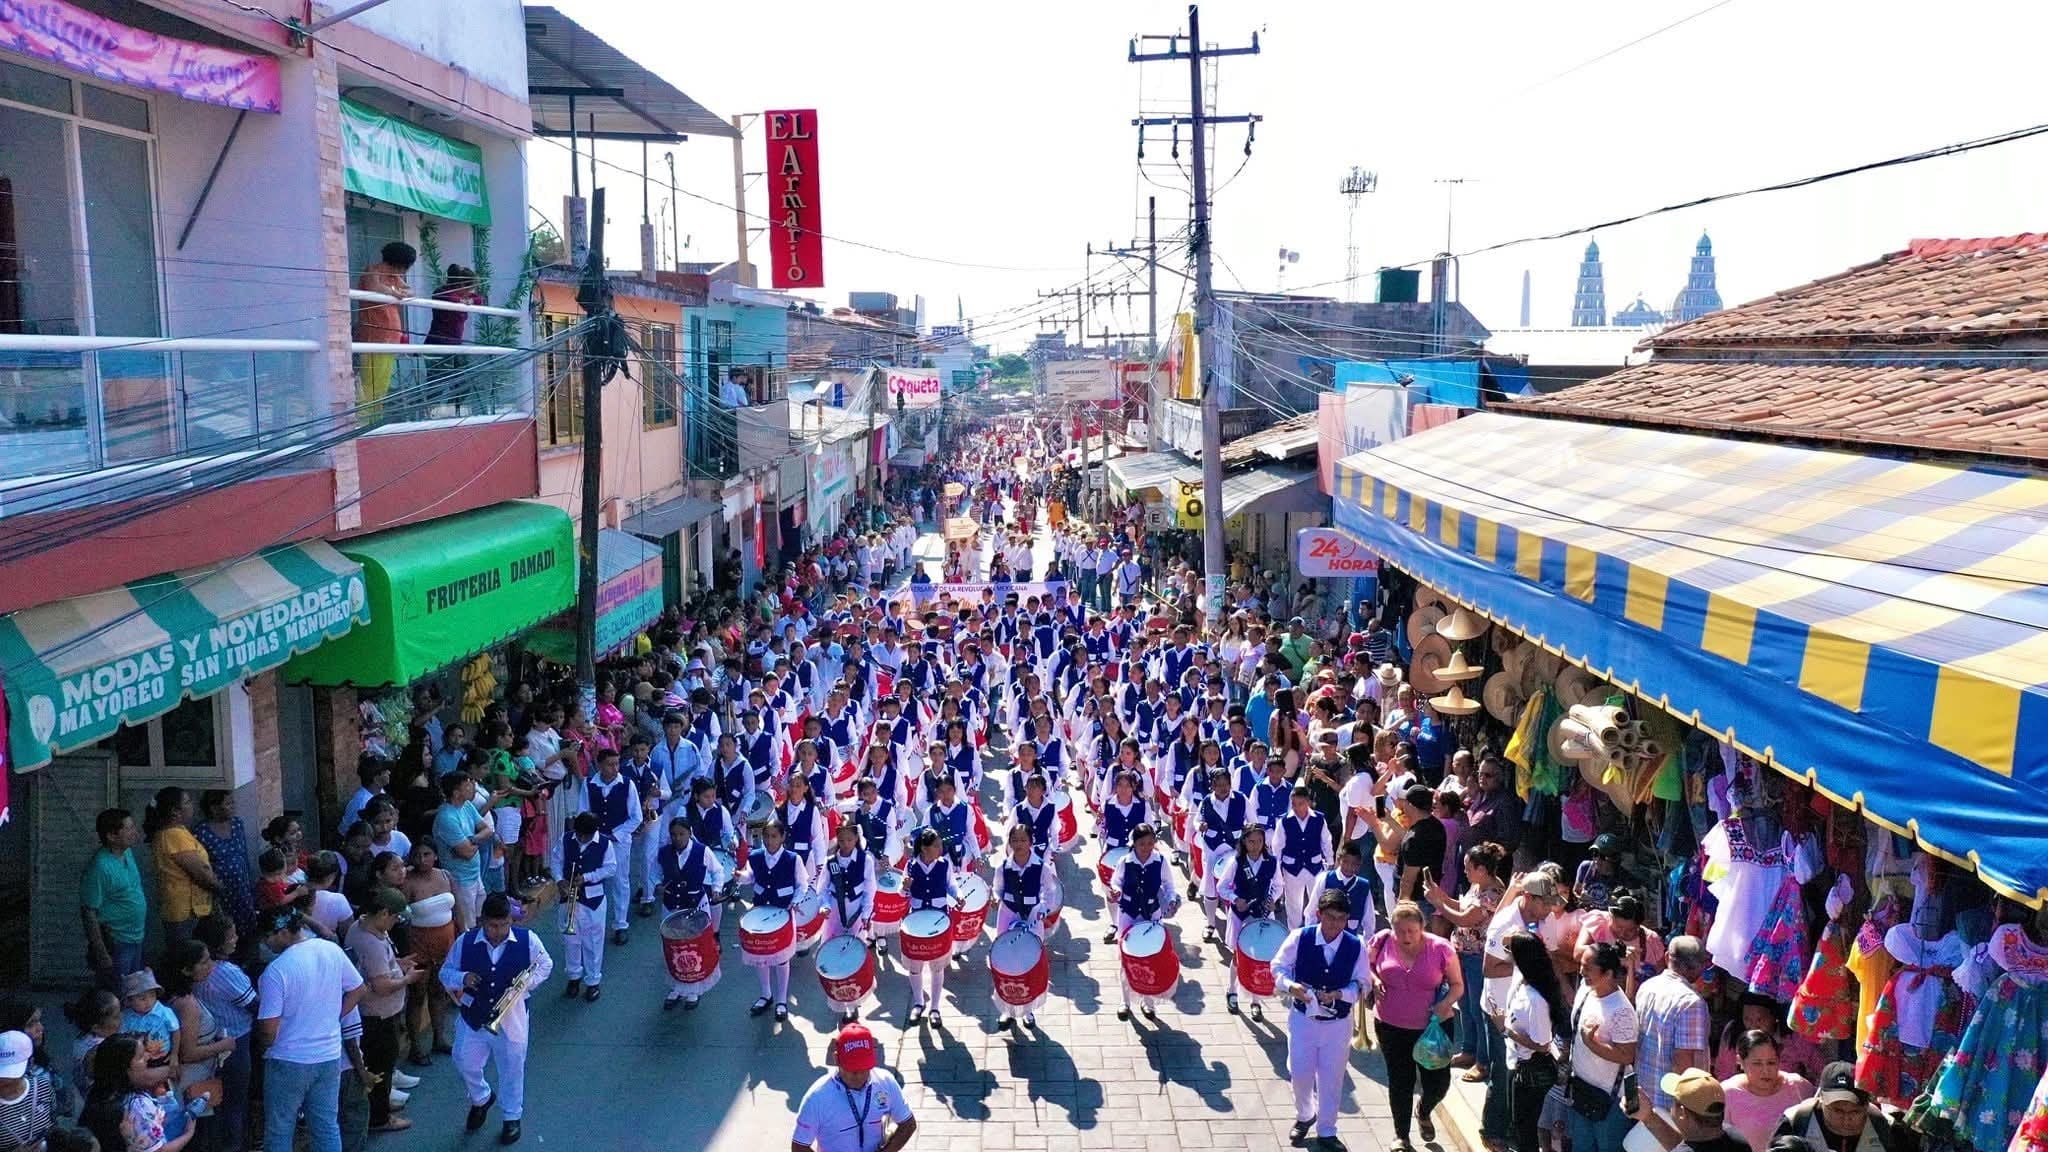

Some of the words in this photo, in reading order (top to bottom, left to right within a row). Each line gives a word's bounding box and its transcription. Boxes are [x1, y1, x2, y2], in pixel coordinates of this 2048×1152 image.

[769, 113, 809, 140] EL
[780, 145, 807, 281] Armario
[889, 376, 939, 399] Coqueta
[1309, 537, 1340, 558] 24
[426, 568, 502, 614] FRUTERIA
[510, 549, 556, 584] DAMADI
[59, 676, 166, 736] MAYOREO
[181, 652, 221, 687] SAN
[226, 631, 280, 669] JUDAS
[286, 600, 351, 643] MENUDEO
[61, 640, 175, 709] MODAS
[180, 634, 202, 660] Y
[209, 581, 342, 651] NOVEDADES
